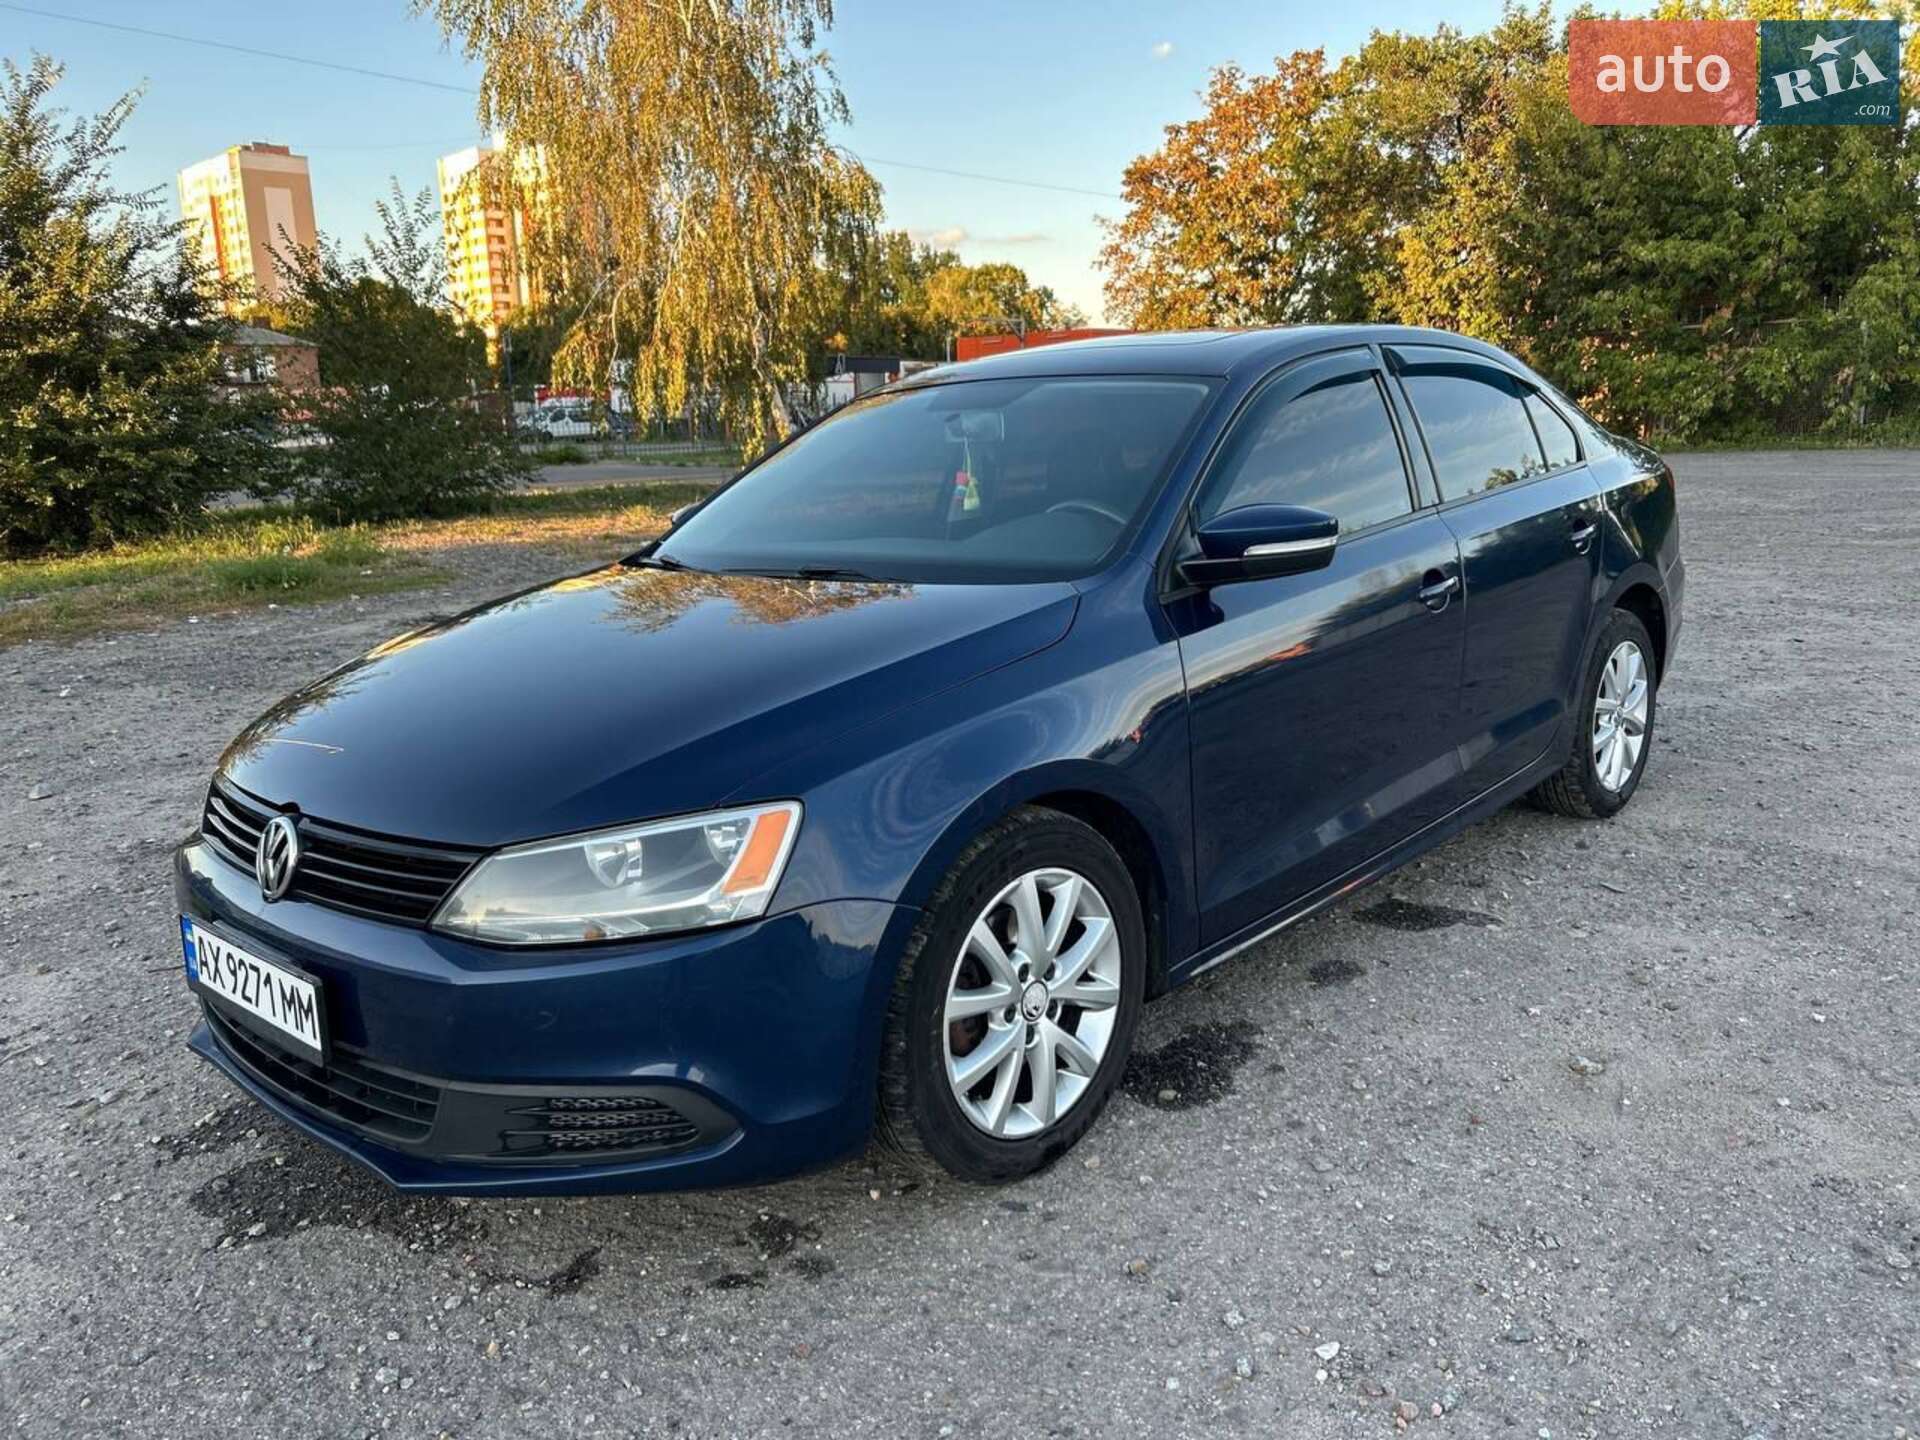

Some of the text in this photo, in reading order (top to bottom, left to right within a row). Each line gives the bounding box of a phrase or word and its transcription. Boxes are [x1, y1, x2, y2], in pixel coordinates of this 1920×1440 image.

[198, 935, 318, 1041] AX 9271 MM
